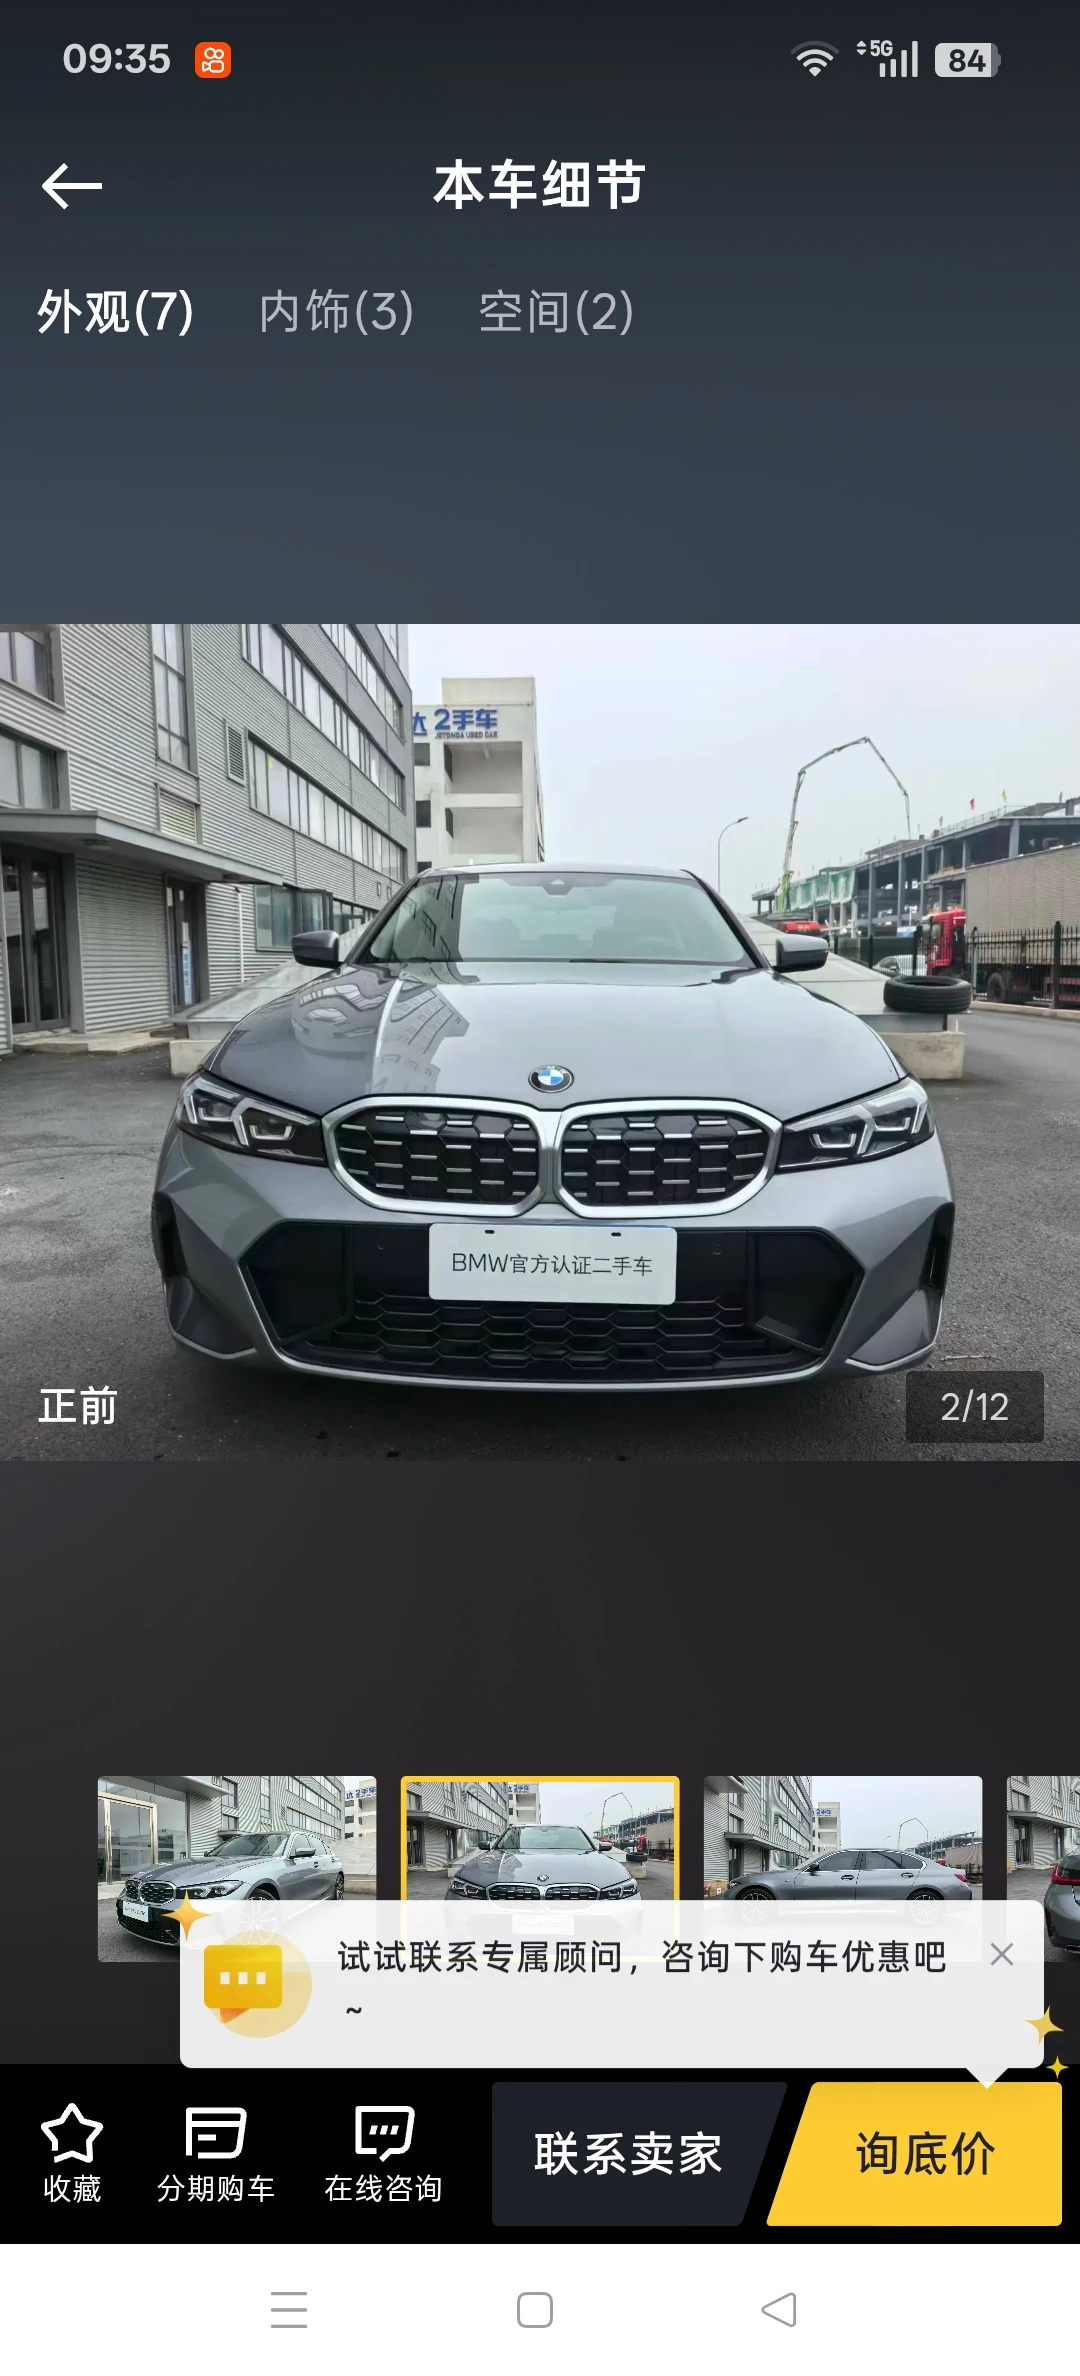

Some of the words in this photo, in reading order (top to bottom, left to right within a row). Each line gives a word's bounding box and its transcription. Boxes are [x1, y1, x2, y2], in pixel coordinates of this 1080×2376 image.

[63, 43, 171, 74] 09:35
[870, 40, 893, 57] 5G
[949, 49, 986, 72] 84
[433, 158, 646, 209] 本车细节
[37, 289, 193, 336] 外观(7)
[261, 289, 413, 336] 内饰(3)
[479, 289, 633, 336] 空间(2)
[451, 1252, 653, 1277] BMW官方认证二手车
[337, 1940, 947, 1976] 试试联系专属顾问，咨询下购车优惠吧
[534, 2131, 723, 2176] 联系卖家
[856, 2131, 996, 2176] 询底价
[43, 2174, 102, 2203] 收藏
[156, 2174, 275, 2203] 分期购车
[324, 2174, 442, 2203] 在线咨询
